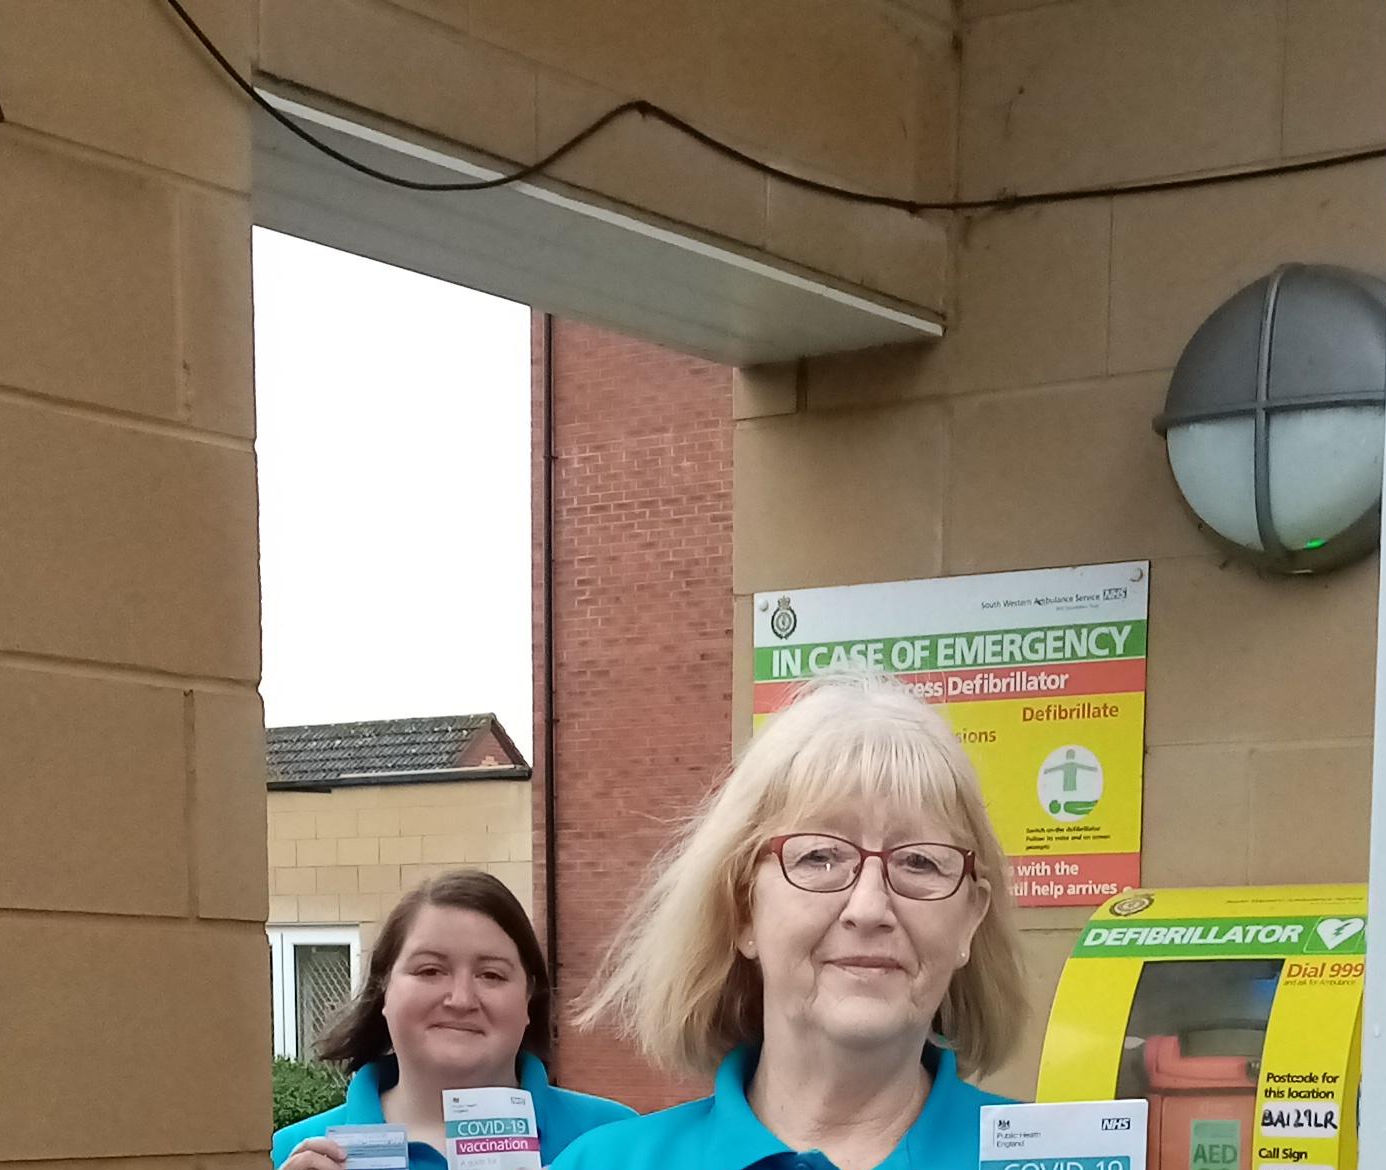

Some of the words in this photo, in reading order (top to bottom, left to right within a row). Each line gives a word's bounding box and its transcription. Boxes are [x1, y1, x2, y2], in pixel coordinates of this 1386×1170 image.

[772, 648, 802, 677] IN
[808, 642, 884, 675] CASE
[891, 639, 930, 670] OF
[937, 625, 1133, 667] EMERGENCY
[947, 671, 1069, 697] Defibrillator
[1022, 702, 1120, 722] Defibrillate
[1017, 861, 1051, 877] with
[1054, 860, 1079, 876] the
[1031, 880, 1064, 899] help
[1066, 880, 1118, 895] arrives
[1083, 924, 1304, 947] DEFIBRILLATOR
[1286, 962, 1327, 979] Dial
[1329, 962, 1365, 979] 999
[1266, 1072, 1319, 1083] Postcode
[1321, 1071, 1340, 1083] for
[1264, 1087, 1286, 1099] this
[1288, 1087, 1335, 1099] location
[457, 1120, 526, 1136] COVID-19
[1101, 1117, 1131, 1131] NHS
[459, 1138, 529, 1153] vaccination
[1193, 1143, 1238, 1164] AED
[1258, 1148, 1280, 1159] Call
[1281, 1148, 1308, 1162] Sign
